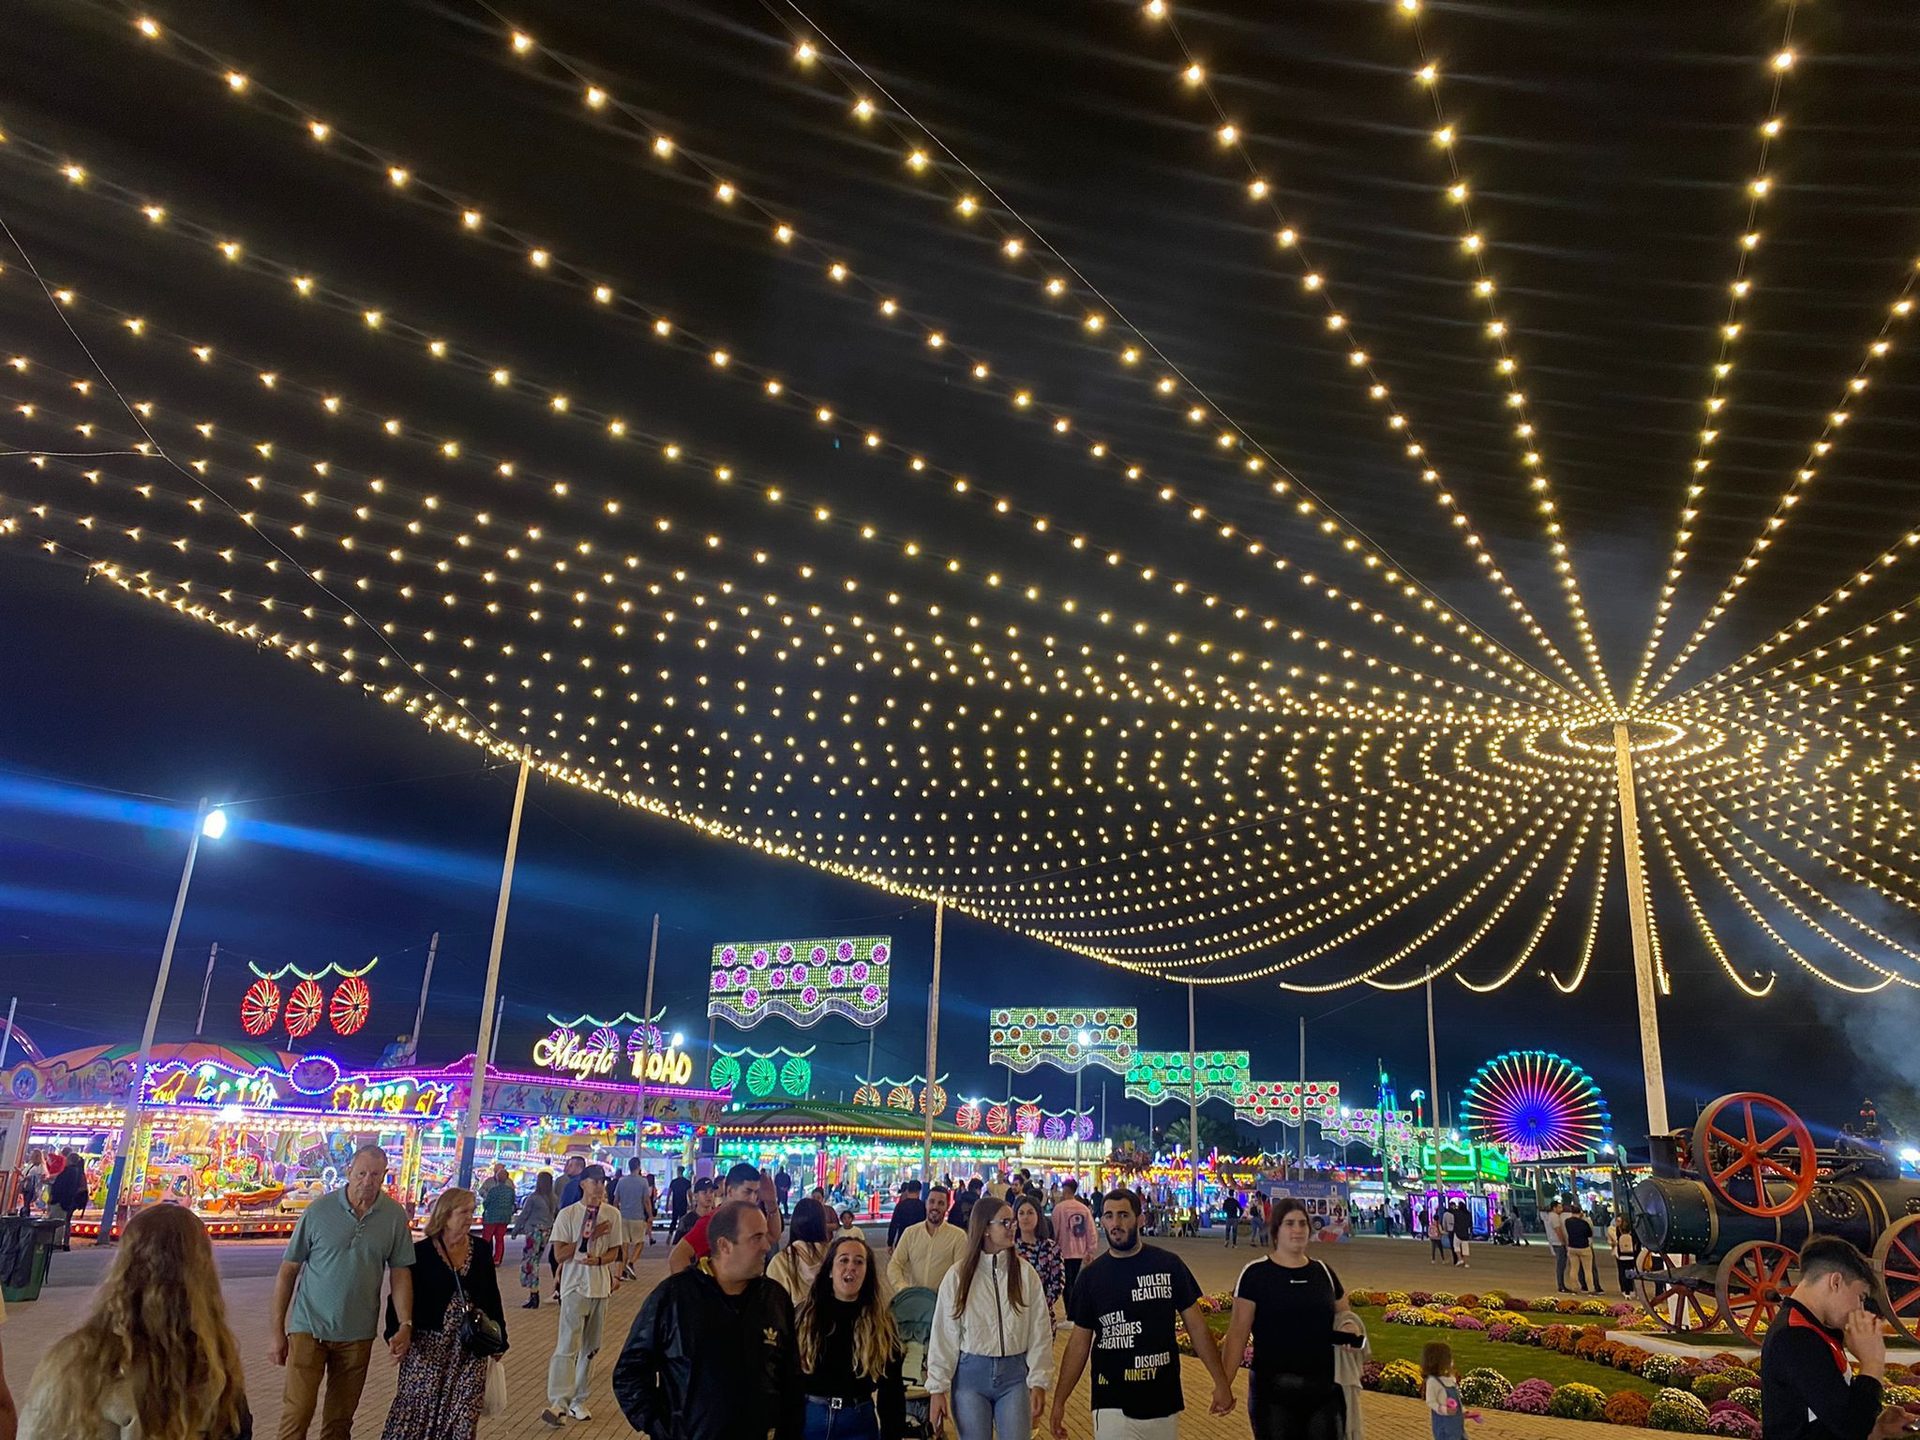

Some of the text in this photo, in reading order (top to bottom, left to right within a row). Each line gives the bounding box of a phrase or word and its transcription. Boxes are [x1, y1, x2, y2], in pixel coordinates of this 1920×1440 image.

[1137, 1273, 1171, 1288] VIOLENT
[1131, 1286, 1172, 1302] REALITIES
[1124, 1367, 1157, 1382] NINETY
